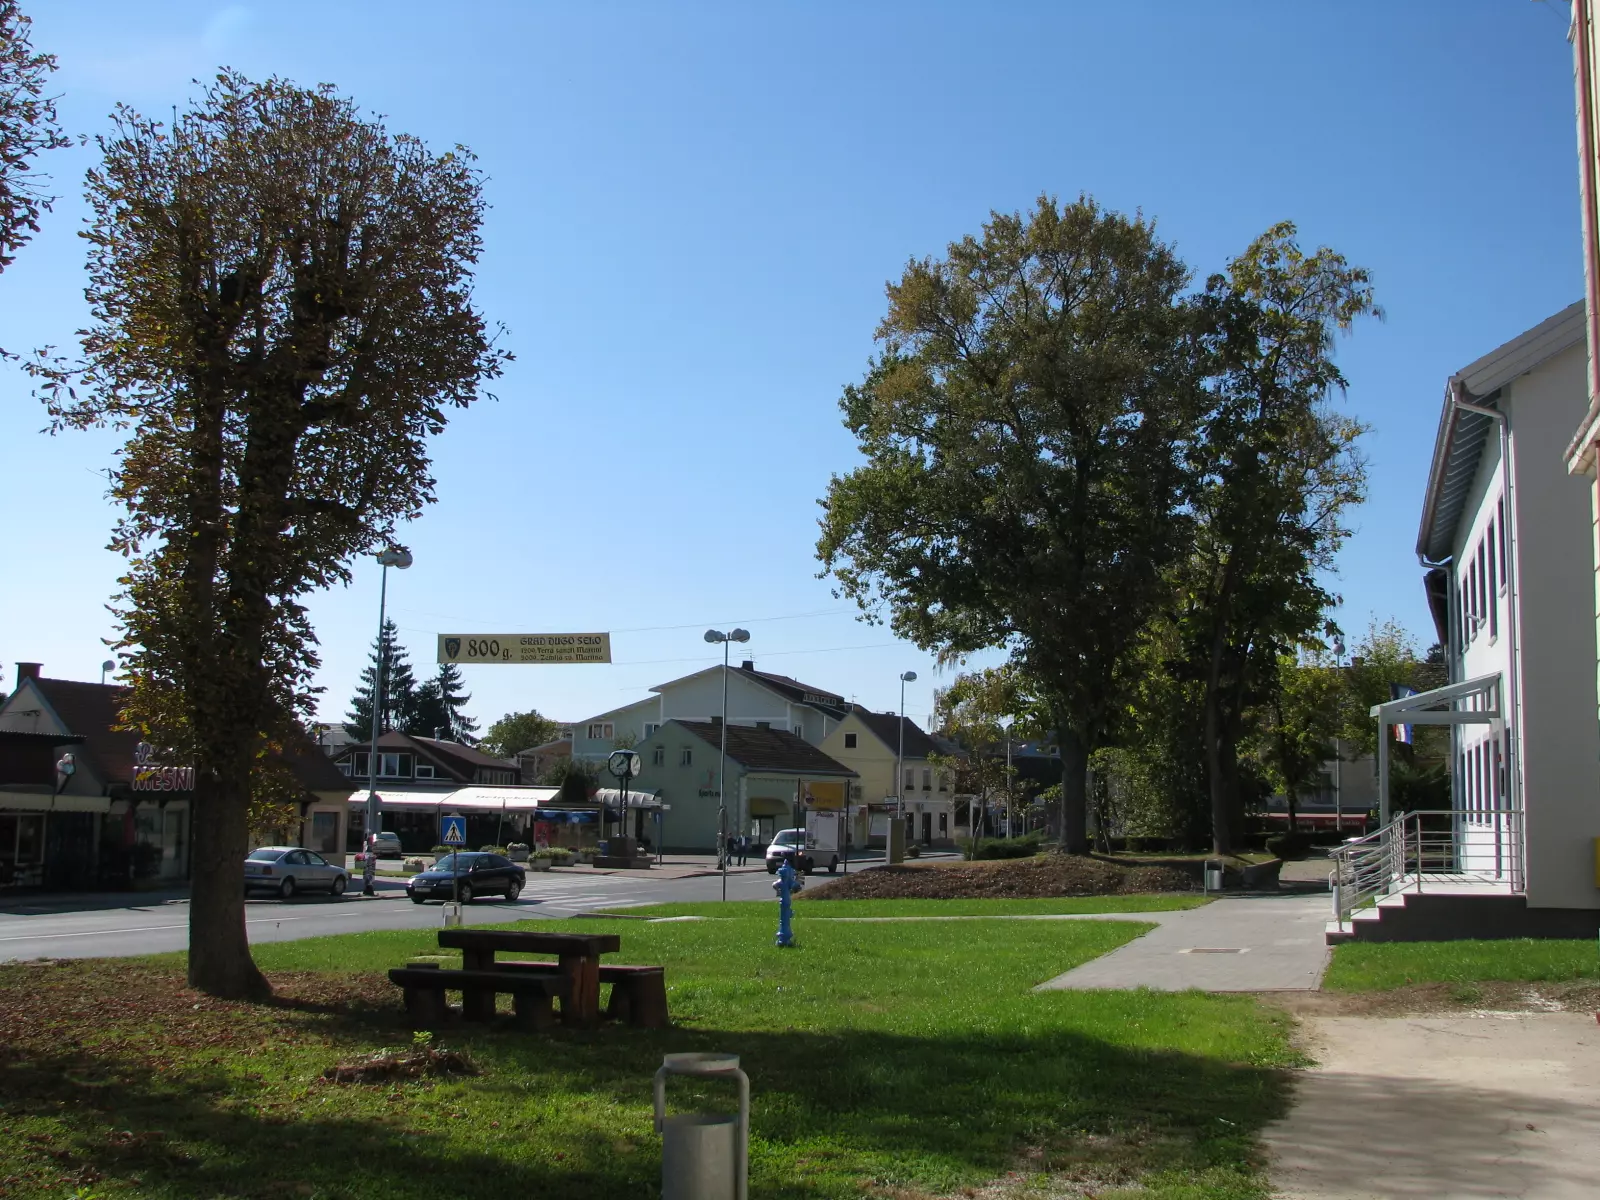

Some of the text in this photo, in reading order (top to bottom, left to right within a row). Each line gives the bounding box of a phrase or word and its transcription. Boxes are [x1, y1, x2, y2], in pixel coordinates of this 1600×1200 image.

[520, 636, 601, 645] GRAD DUGO SELO
[468, 639, 512, 660] 800 g.
